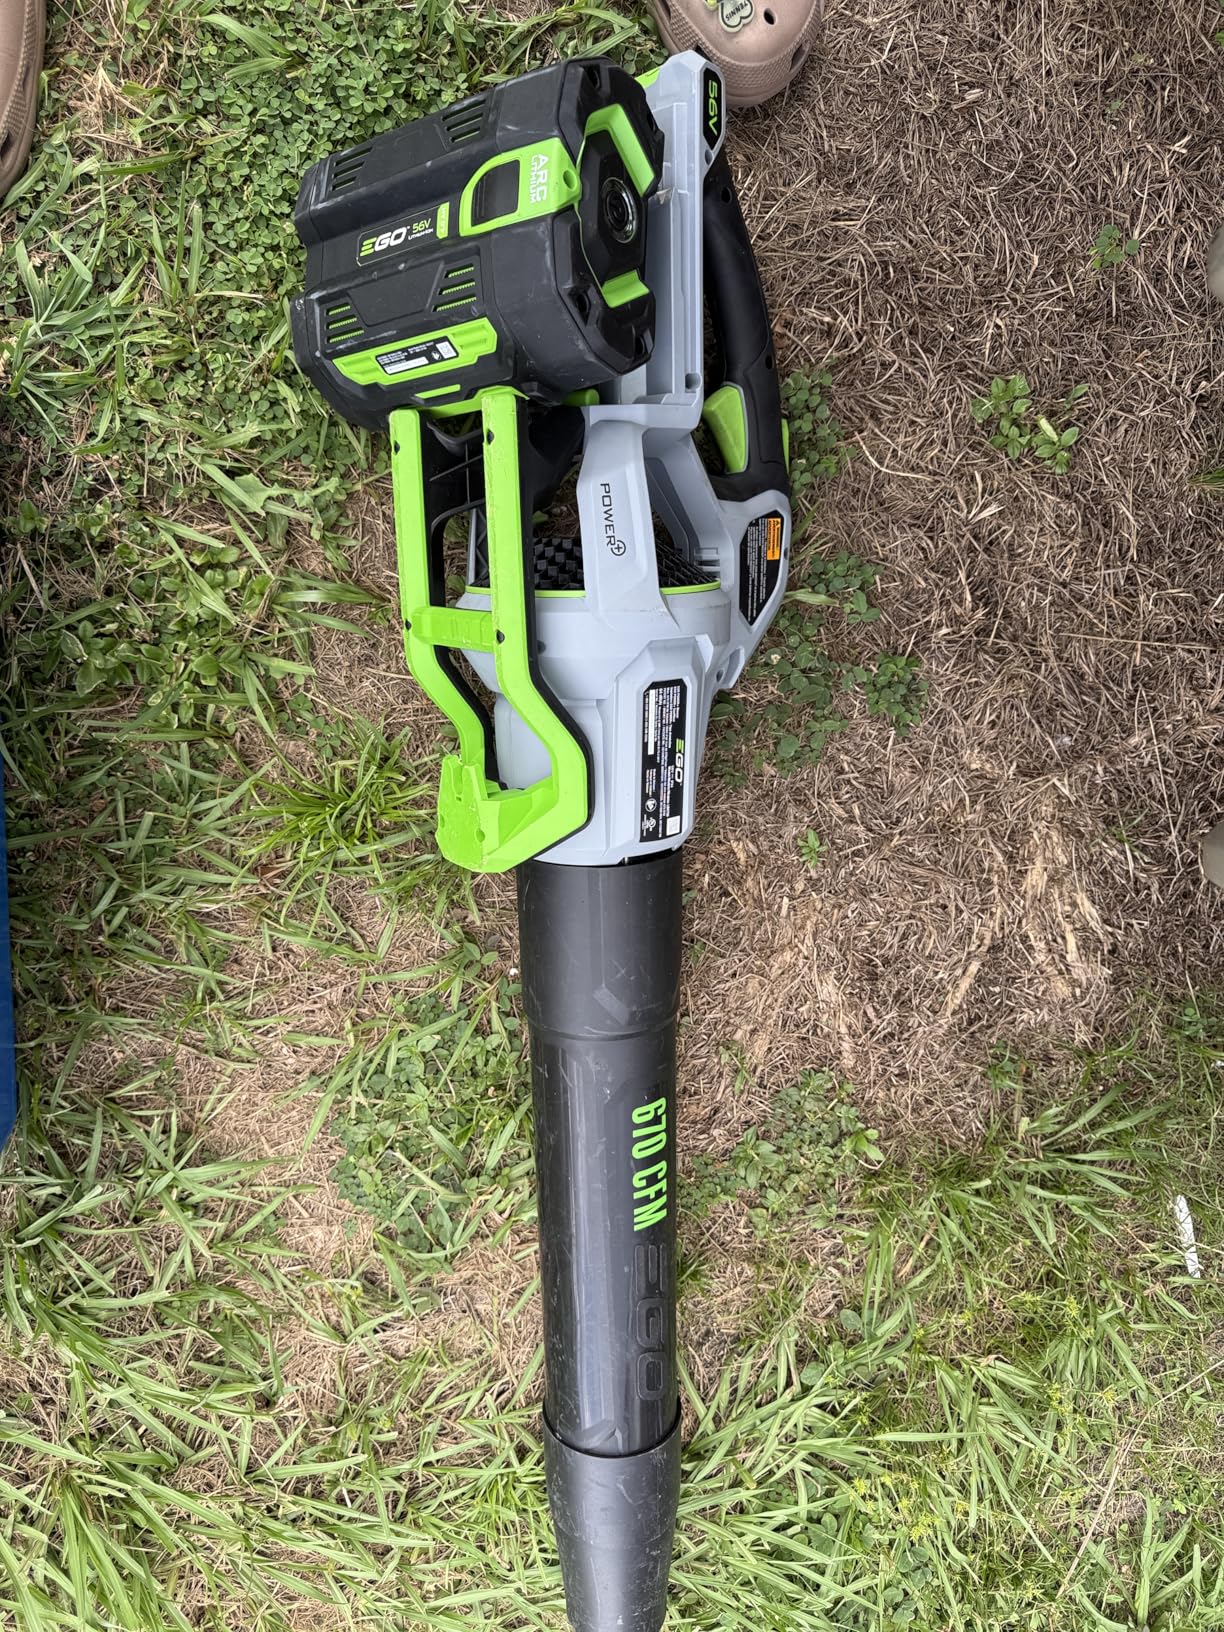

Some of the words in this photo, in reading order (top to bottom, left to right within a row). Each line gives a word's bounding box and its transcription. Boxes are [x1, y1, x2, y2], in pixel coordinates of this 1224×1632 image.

[725, 0, 748, 21] TENNIS
[708, 80, 718, 136] 56V
[529, 154, 538, 204] LITHIUM
[535, 153, 549, 201] ARC
[360, 226, 407, 257] EGO
[412, 218, 431, 234] 56V
[675, 738, 685, 783] EGO
[632, 1097, 667, 1159] 670
[632, 1160, 667, 1232] CFM
[635, 1244, 667, 1401] EGO
